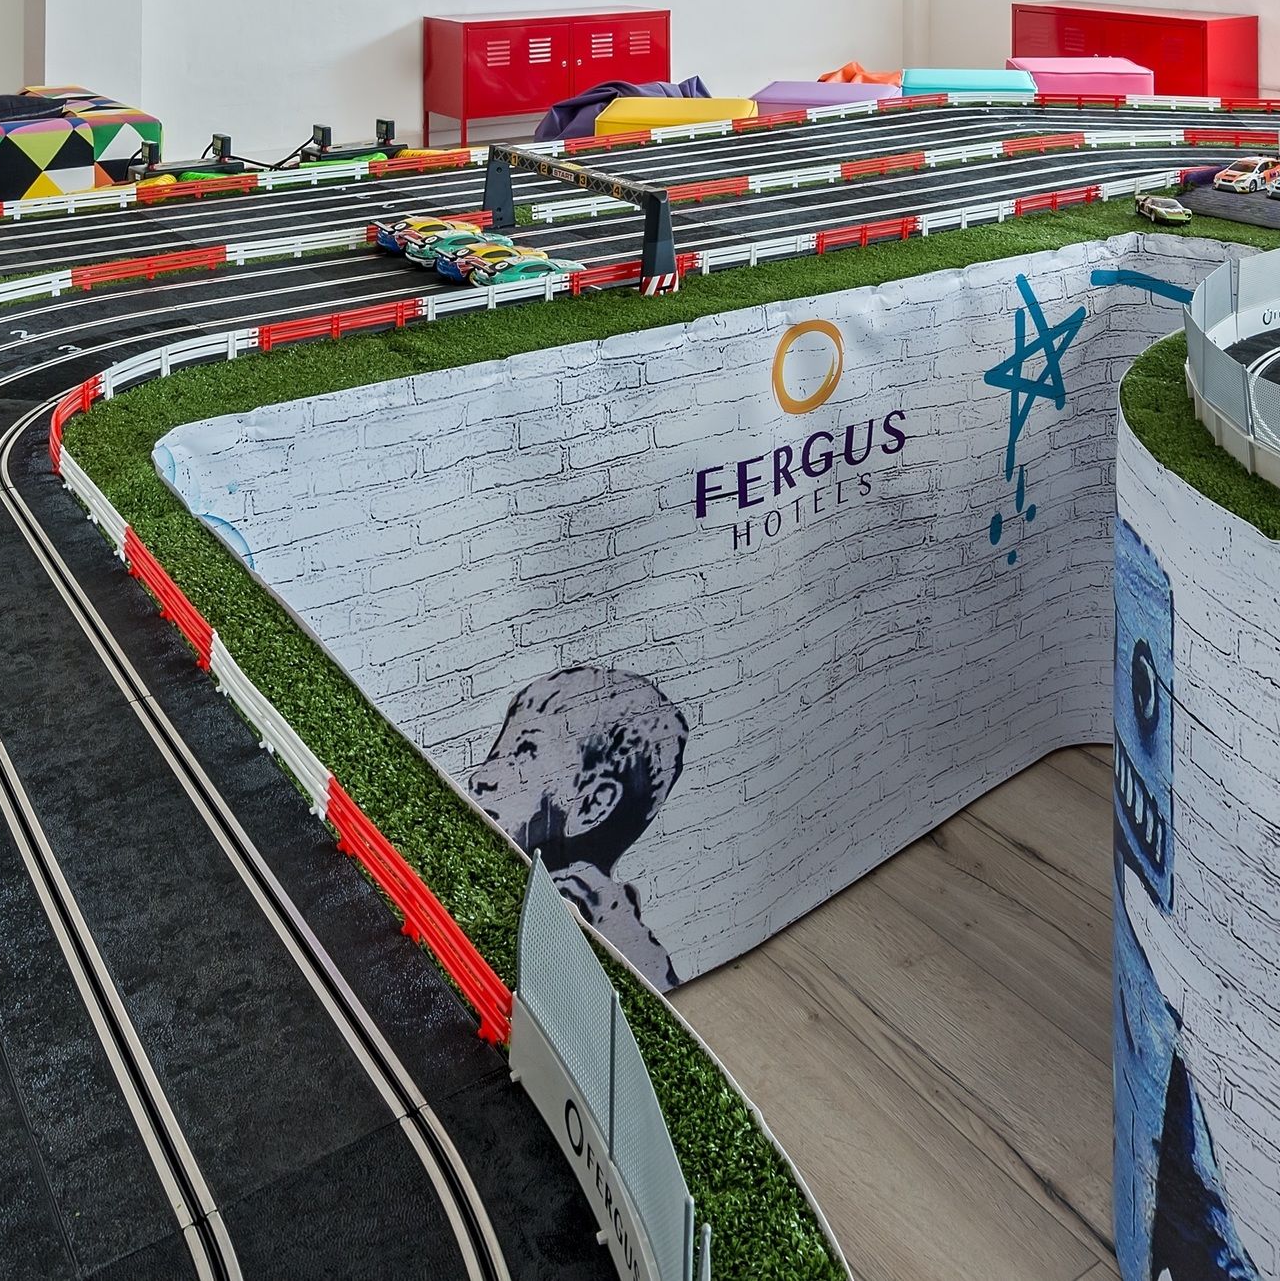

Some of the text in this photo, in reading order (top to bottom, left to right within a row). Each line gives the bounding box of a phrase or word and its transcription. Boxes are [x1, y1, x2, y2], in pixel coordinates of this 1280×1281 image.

[552, 169, 574, 181] START
[695, 410, 906, 518] FERGUS
[733, 472, 872, 550] HOTELS
